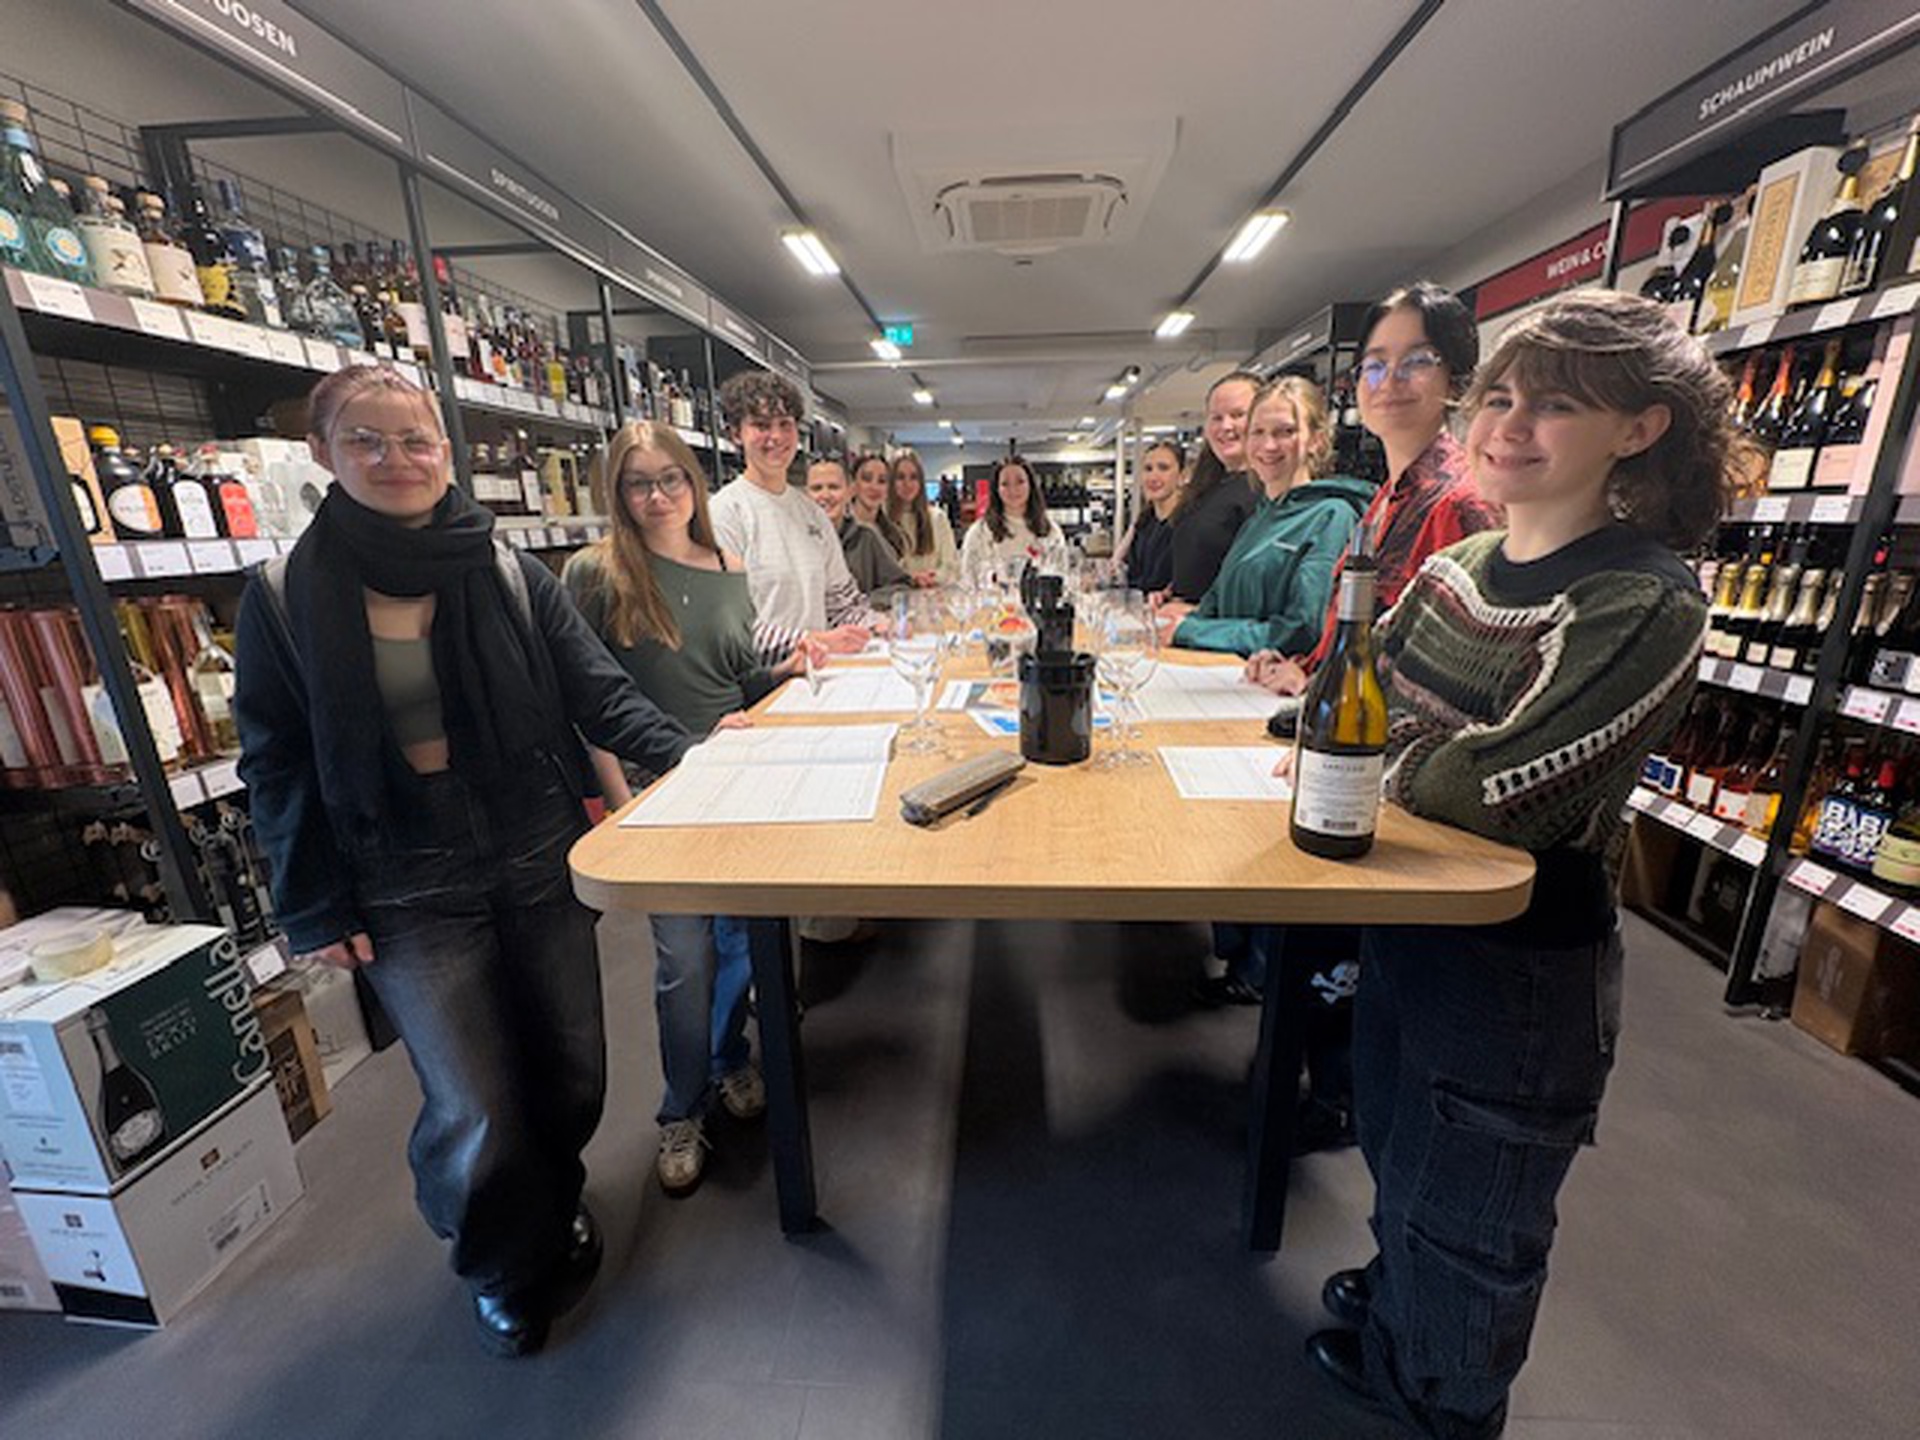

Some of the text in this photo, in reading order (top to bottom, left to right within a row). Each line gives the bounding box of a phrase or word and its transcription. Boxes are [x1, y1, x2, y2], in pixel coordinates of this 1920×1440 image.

[205, 0, 297, 57] UOSEN
[1698, 27, 1835, 120] SCHAUMWEIN
[1546, 254, 1579, 279] WEIN
[203, 936, 271, 1083] Canella
